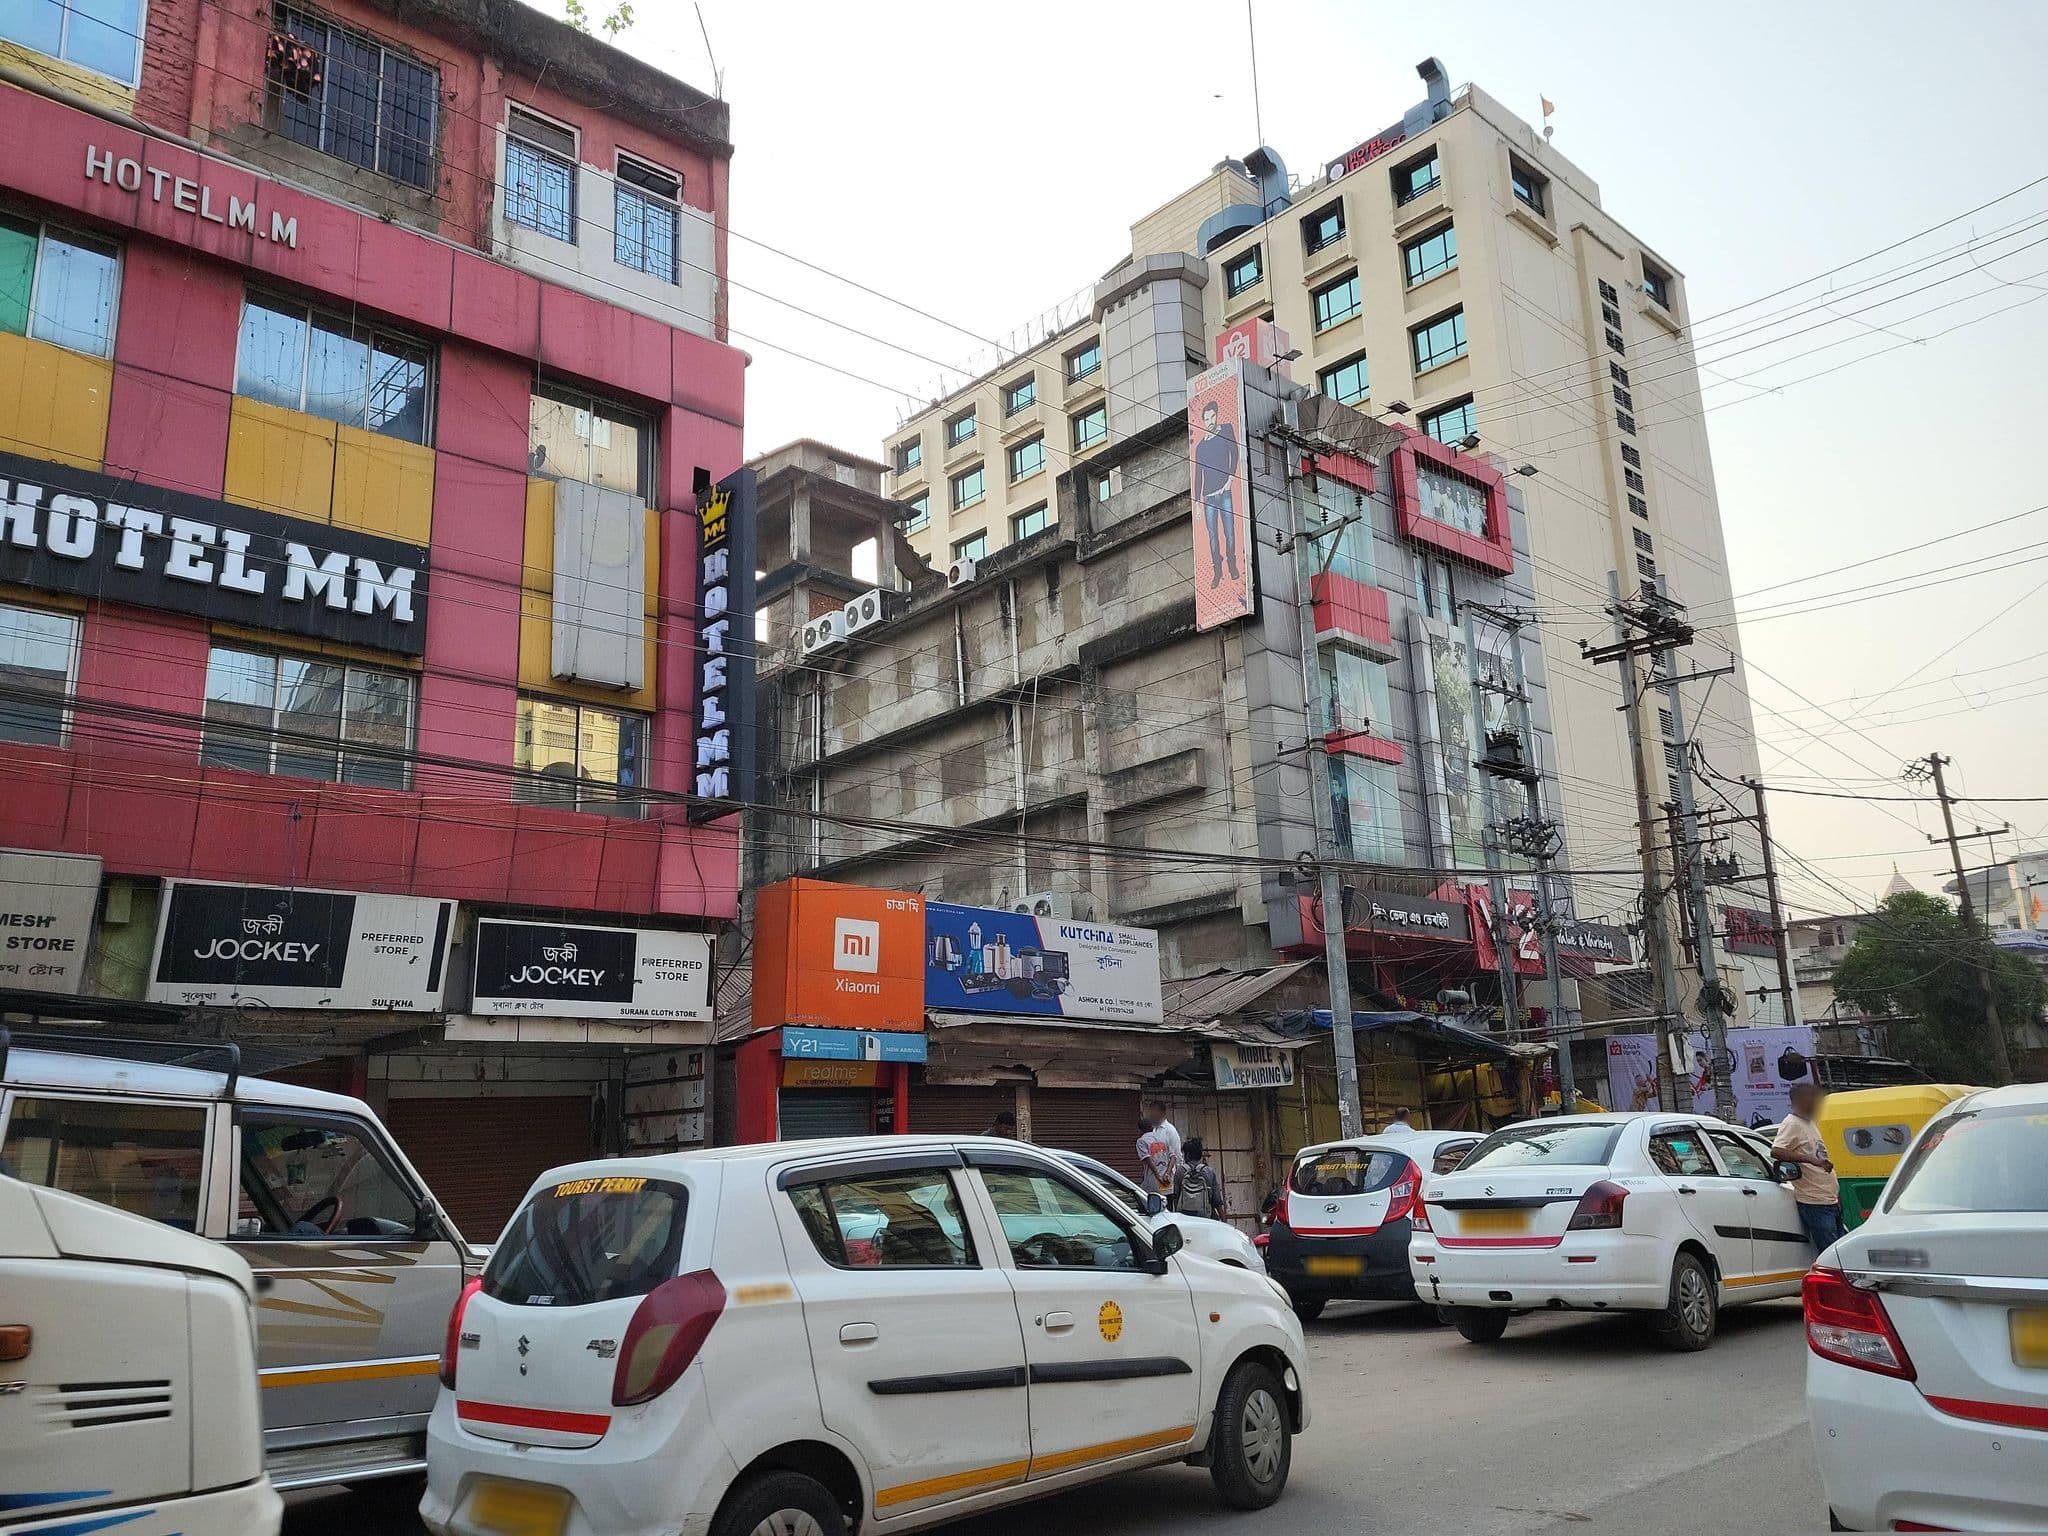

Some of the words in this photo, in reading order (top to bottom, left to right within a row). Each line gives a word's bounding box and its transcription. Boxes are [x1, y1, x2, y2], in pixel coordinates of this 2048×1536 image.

[1350, 138, 1384, 163] HOTEL
[704, 523, 727, 543] MM
[0, 479, 266, 595] HOTEL
[282, 541, 416, 623] MM
[703, 548, 729, 729] HOTEL
[696, 729, 731, 798] MM
[7, 936, 76, 952] STORE
[361, 932, 424, 944] PREFERRED
[1118, 932, 1137, 941] SMALL
[1584, 930, 1614, 958] Variety
[193, 938, 320, 963] JOCKEY
[374, 945, 409, 955] STORE
[1078, 942, 1099, 950] Designed
[1118, 940, 1153, 949] APPLIANCES
[641, 957, 703, 970] PREFERRED
[510, 965, 606, 987] JOCKEY
[655, 971, 690, 982] STORE
[835, 978, 880, 995] Xiaomi
[371, 998, 414, 1008] SULEKHA
[1078, 996, 1099, 1005] ASHOK
[620, 1007, 650, 1017] SURANA
[651, 1009, 674, 1018] CLOTH
[675, 1010, 698, 1018] STORE
[789, 1038, 818, 1052] Y21
[1238, 1047, 1273, 1063] MOBILE
[803, 1065, 857, 1080] realme
[1315, 1163, 1340, 1171] TOURIST
[553, 1179, 600, 1198] TOURIST
[598, 1178, 648, 1194] PERMIT
